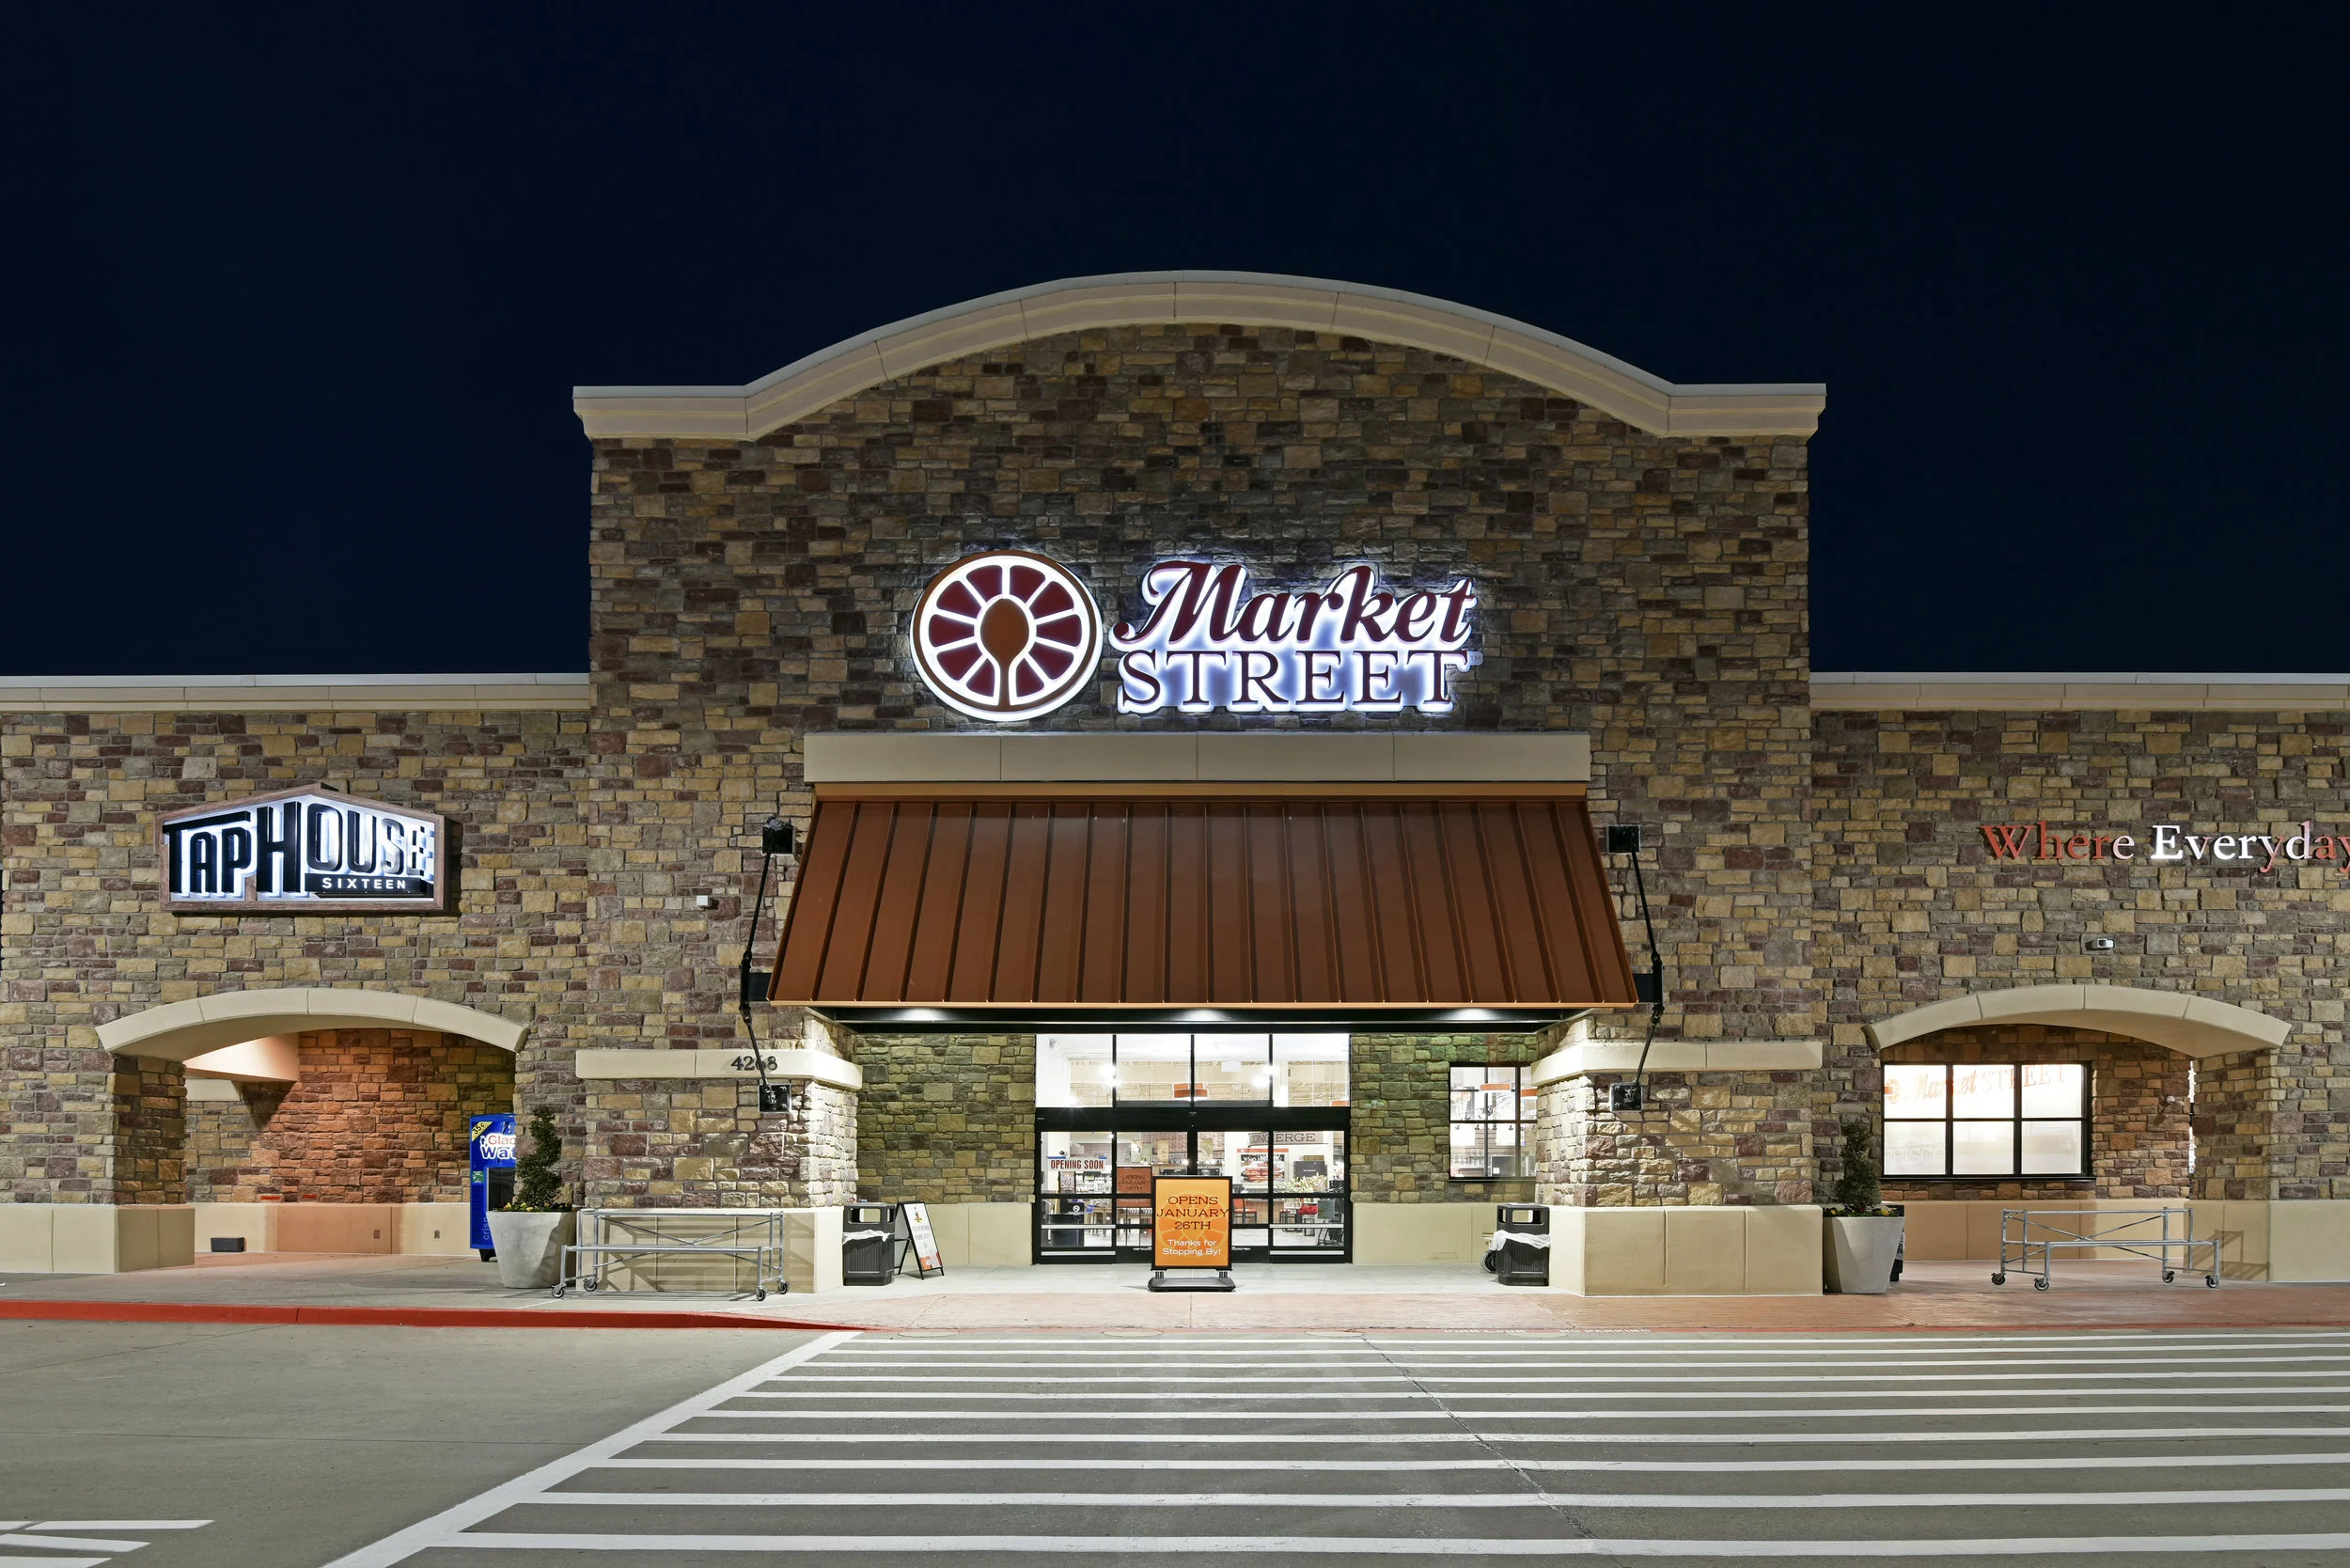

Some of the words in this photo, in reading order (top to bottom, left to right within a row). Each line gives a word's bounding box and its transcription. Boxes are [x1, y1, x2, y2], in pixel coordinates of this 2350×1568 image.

[1112, 559, 1477, 644] Market
[1121, 648, 1468, 706] STREET
[1980, 821, 2135, 860] Where
[2150, 820, 2350, 873] Everyday
[321, 876, 407, 890] SIXTEEN
[729, 1056, 778, 1071] 4268
[1904, 1069, 1978, 1103] Maret
[1250, 1133, 1316, 1143] ONCERGE
[1050, 1159, 1082, 1169] OPENING
[1083, 1159, 1104, 1169] SOON
[1167, 1196, 1218, 1205] OPENS
[1156, 1208, 1230, 1217] JANUARY
[1174, 1221, 1212, 1231] 26TH
[1167, 1238, 1201, 1247] Thanks
[1162, 1247, 1203, 1257] Stopping
[1205, 1247, 1221, 1256] By!
